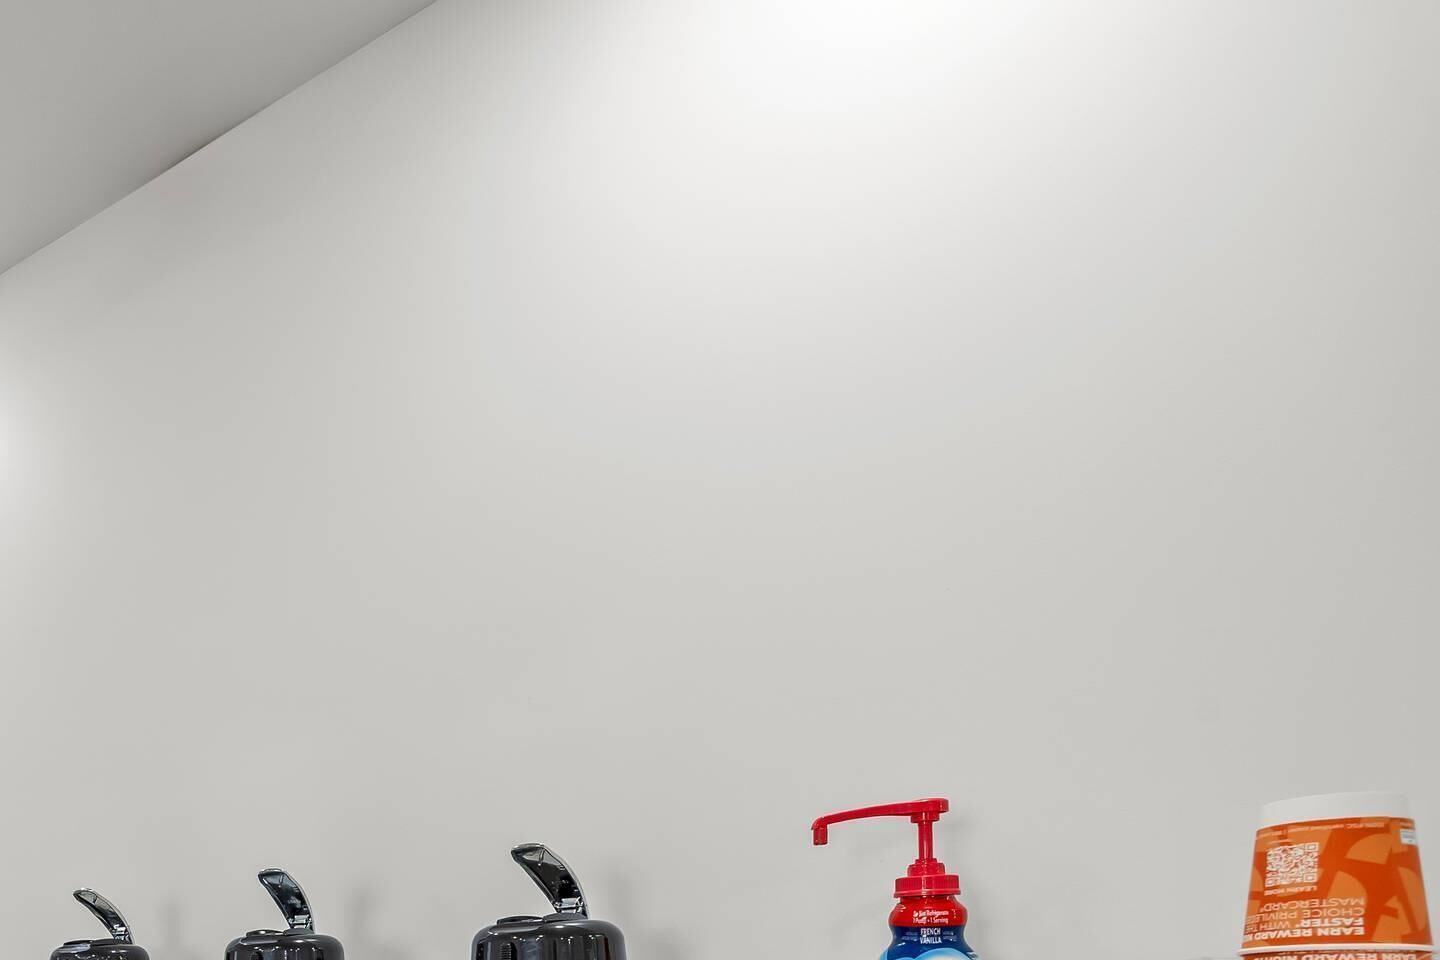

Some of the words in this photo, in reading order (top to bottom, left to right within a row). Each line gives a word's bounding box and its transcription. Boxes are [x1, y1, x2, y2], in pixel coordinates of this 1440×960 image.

[1303, 907, 1365, 918] CHOICE
[1260, 921, 1290, 931] WITH
[920, 927, 941, 935] FRENCH
[1254, 928, 1313, 940] REWARD
[1317, 927, 1365, 936] EARN
[920, 936, 943, 944] VANILLA
